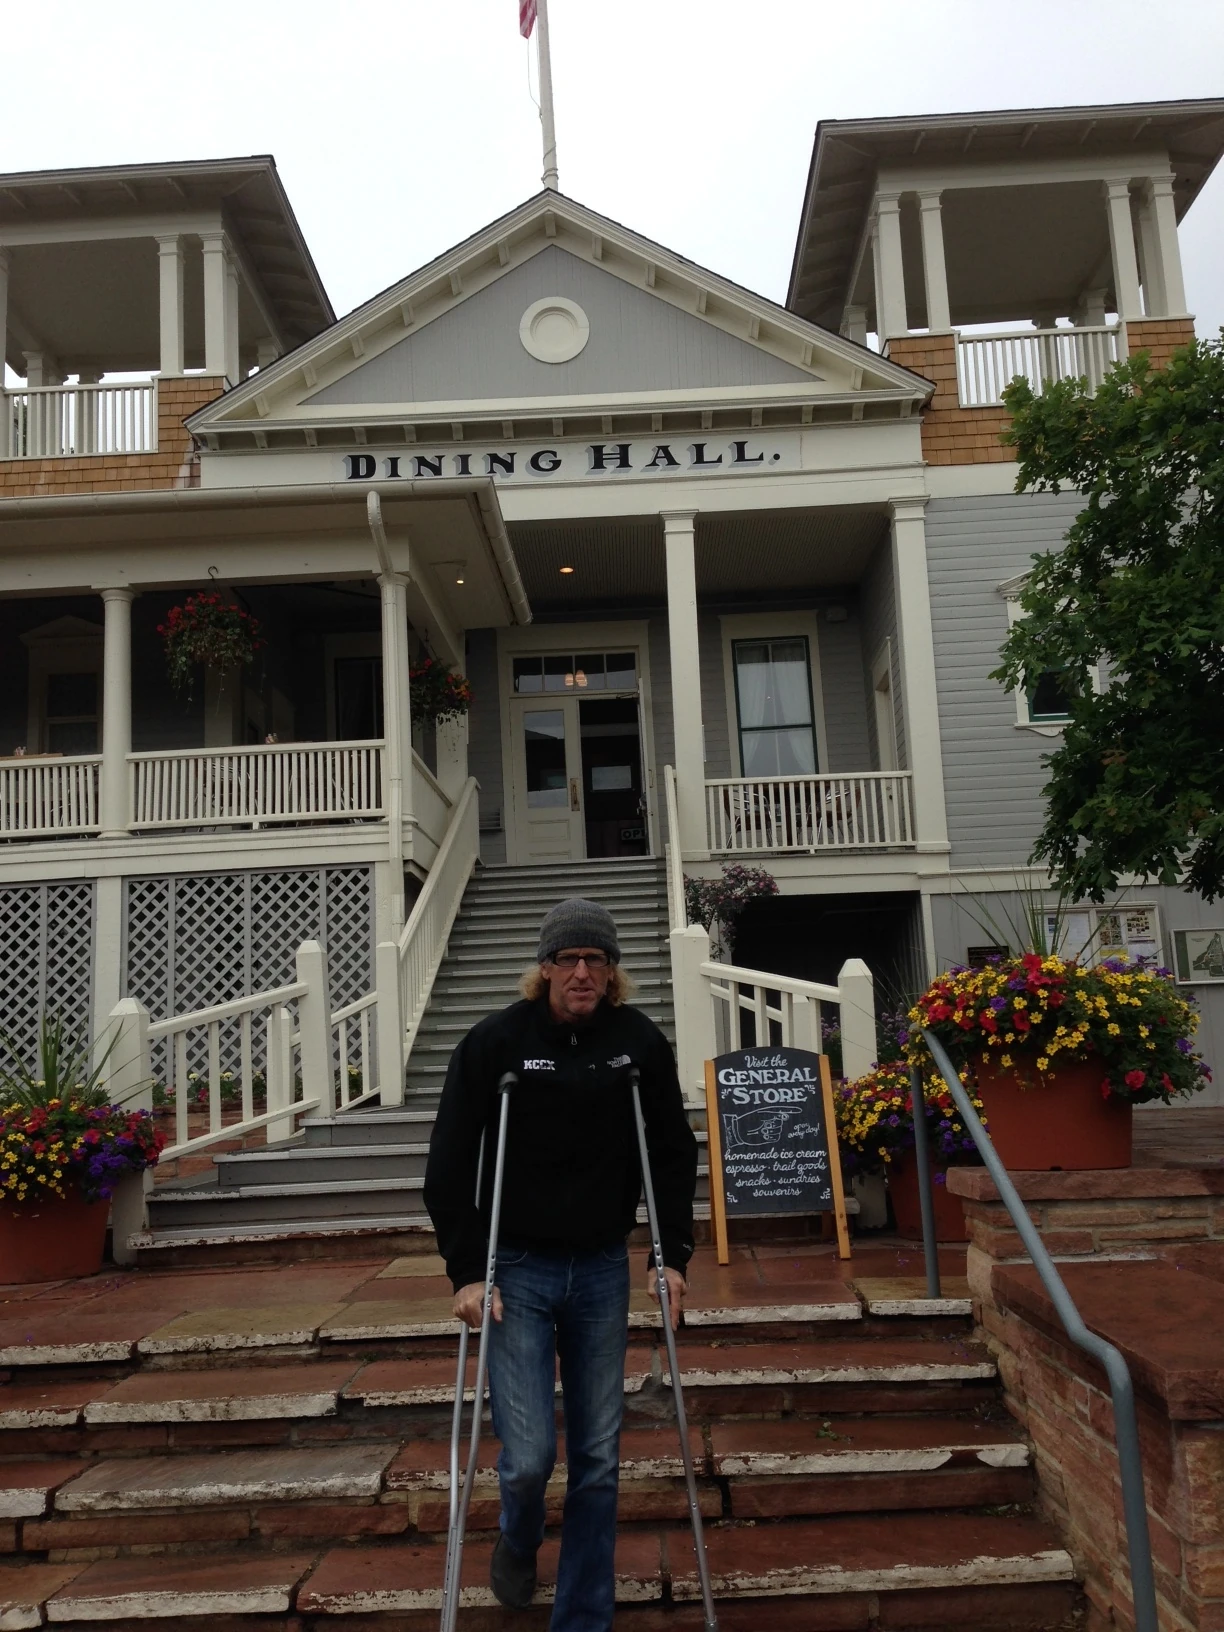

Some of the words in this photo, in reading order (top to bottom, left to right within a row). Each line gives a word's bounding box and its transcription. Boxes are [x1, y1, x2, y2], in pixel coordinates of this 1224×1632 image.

[345, 449, 563, 480] DINING
[588, 440, 782, 471] HALL.
[745, 1055, 769, 1068] Visit
[770, 1054, 788, 1067] the
[718, 1067, 817, 1086] GENERAL
[732, 1087, 808, 1105] STORE
[724, 1149, 779, 1161] homemade
[780, 1149, 795, 1159] ice
[795, 1150, 827, 1159] cream
[725, 1164, 766, 1177] espresso
[772, 1160, 796, 1172] trail
[797, 1158, 827, 1175] goods
[735, 1173, 771, 1187] snacks
[777, 1171, 821, 1185] sundries
[753, 1186, 802, 1197] souvenirs
